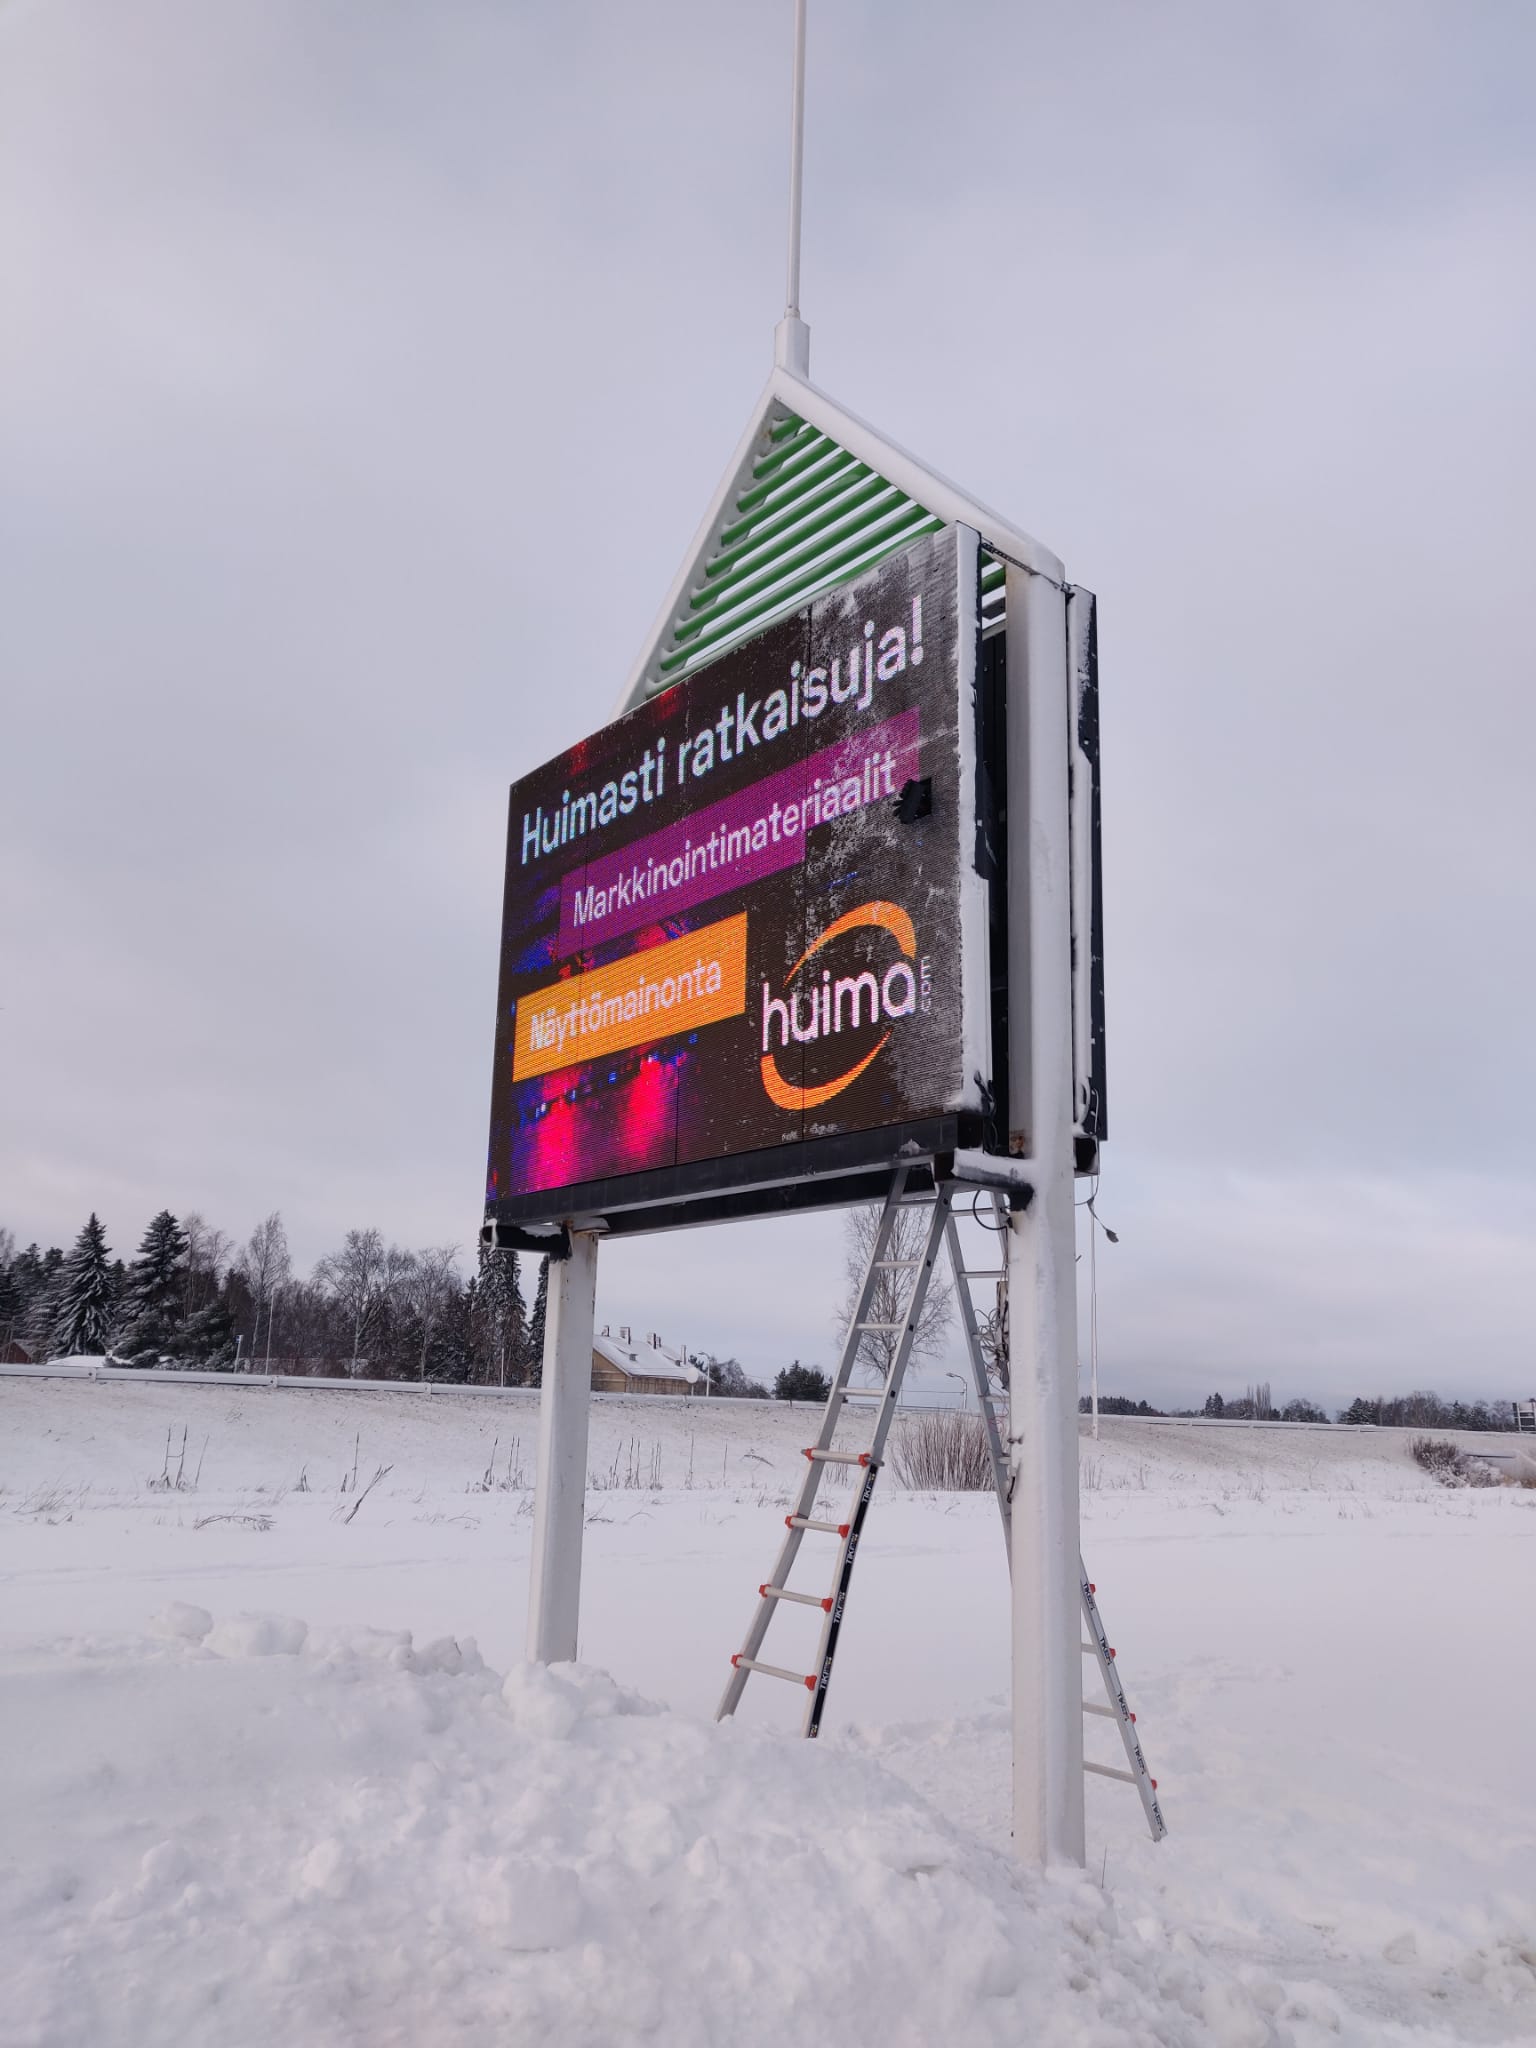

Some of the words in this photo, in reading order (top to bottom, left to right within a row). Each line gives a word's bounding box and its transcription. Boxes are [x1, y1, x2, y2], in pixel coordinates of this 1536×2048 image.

[521, 736, 666, 865] Huimasti
[678, 594, 924, 785] ratkaisuja!
[573, 751, 897, 927] Markkinointimateriaalit
[529, 958, 722, 1052] Näyttömainonta
[762, 962, 916, 1052] huima
